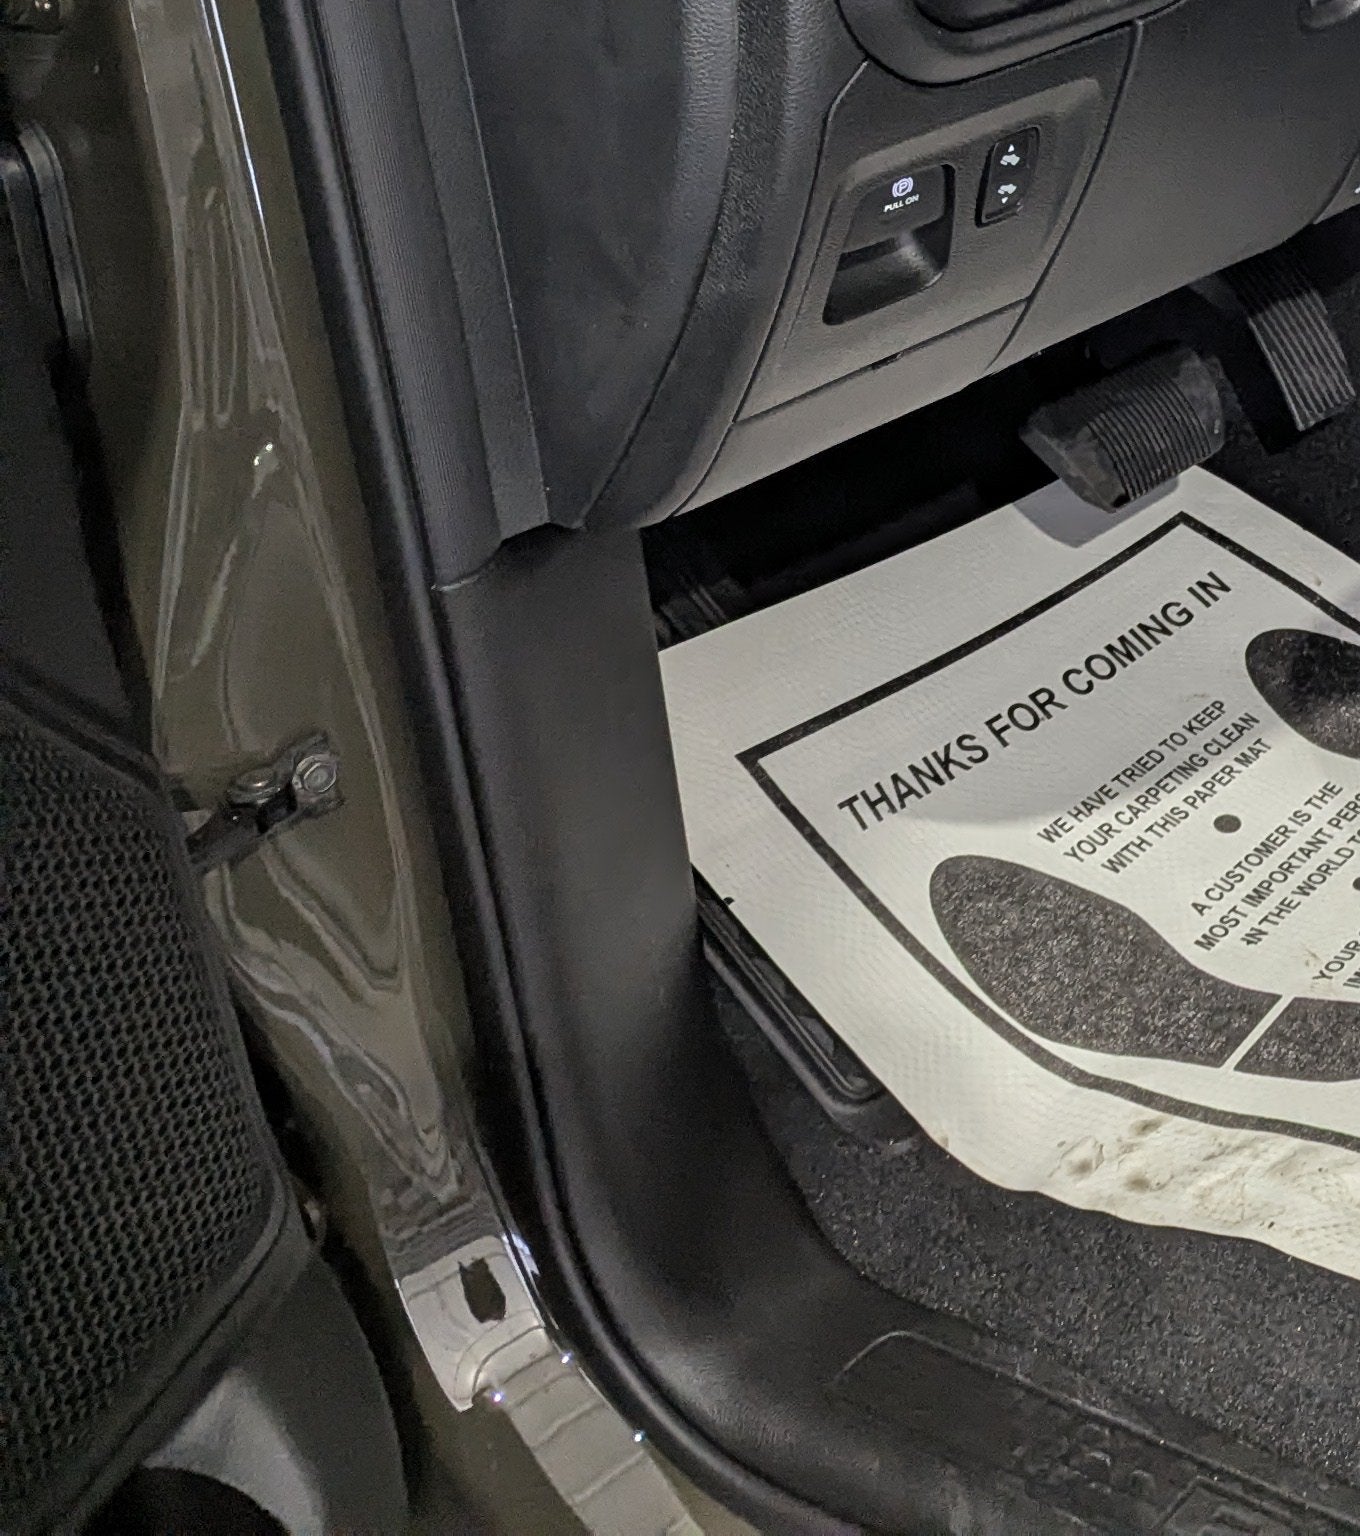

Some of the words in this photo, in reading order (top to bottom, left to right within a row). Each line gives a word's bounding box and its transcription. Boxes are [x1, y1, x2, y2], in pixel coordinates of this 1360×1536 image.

[883, 200, 904, 213] PULL
[905, 193, 920, 205] ON
[838, 733, 989, 831] THANKS
[984, 687, 1068, 748] FOR
[1062, 601, 1195, 695] COMING
[1187, 571, 1232, 609] IN
[1037, 817, 1074, 844] WE
[1067, 784, 1120, 823] HAVE
[1111, 749, 1165, 788] TRIED
[1158, 732, 1188, 752] TO
[1182, 700, 1226, 735] KEEP
[1063, 822, 1121, 863] YOUR
[1114, 753, 1209, 826] CARPETING
[1203, 712, 1260, 756] CLEAN
[1101, 835, 1153, 874] WITH
[1144, 806, 1189, 839] THIS
[1182, 764, 1242, 810] PAPER
[1234, 737, 1272, 768] MAT
[1191, 900, 1212, 917] A
[1204, 823, 1297, 903] CUSTOMER
[1288, 809, 1312, 827] IS
[1303, 781, 1344, 811] THE
[1194, 905, 1248, 951] MOST
[1241, 827, 1334, 909] IMPORTANT
[1240, 926, 1269, 947] IN
[1258, 896, 1301, 928] THE
[1291, 846, 1355, 898] WORLD
